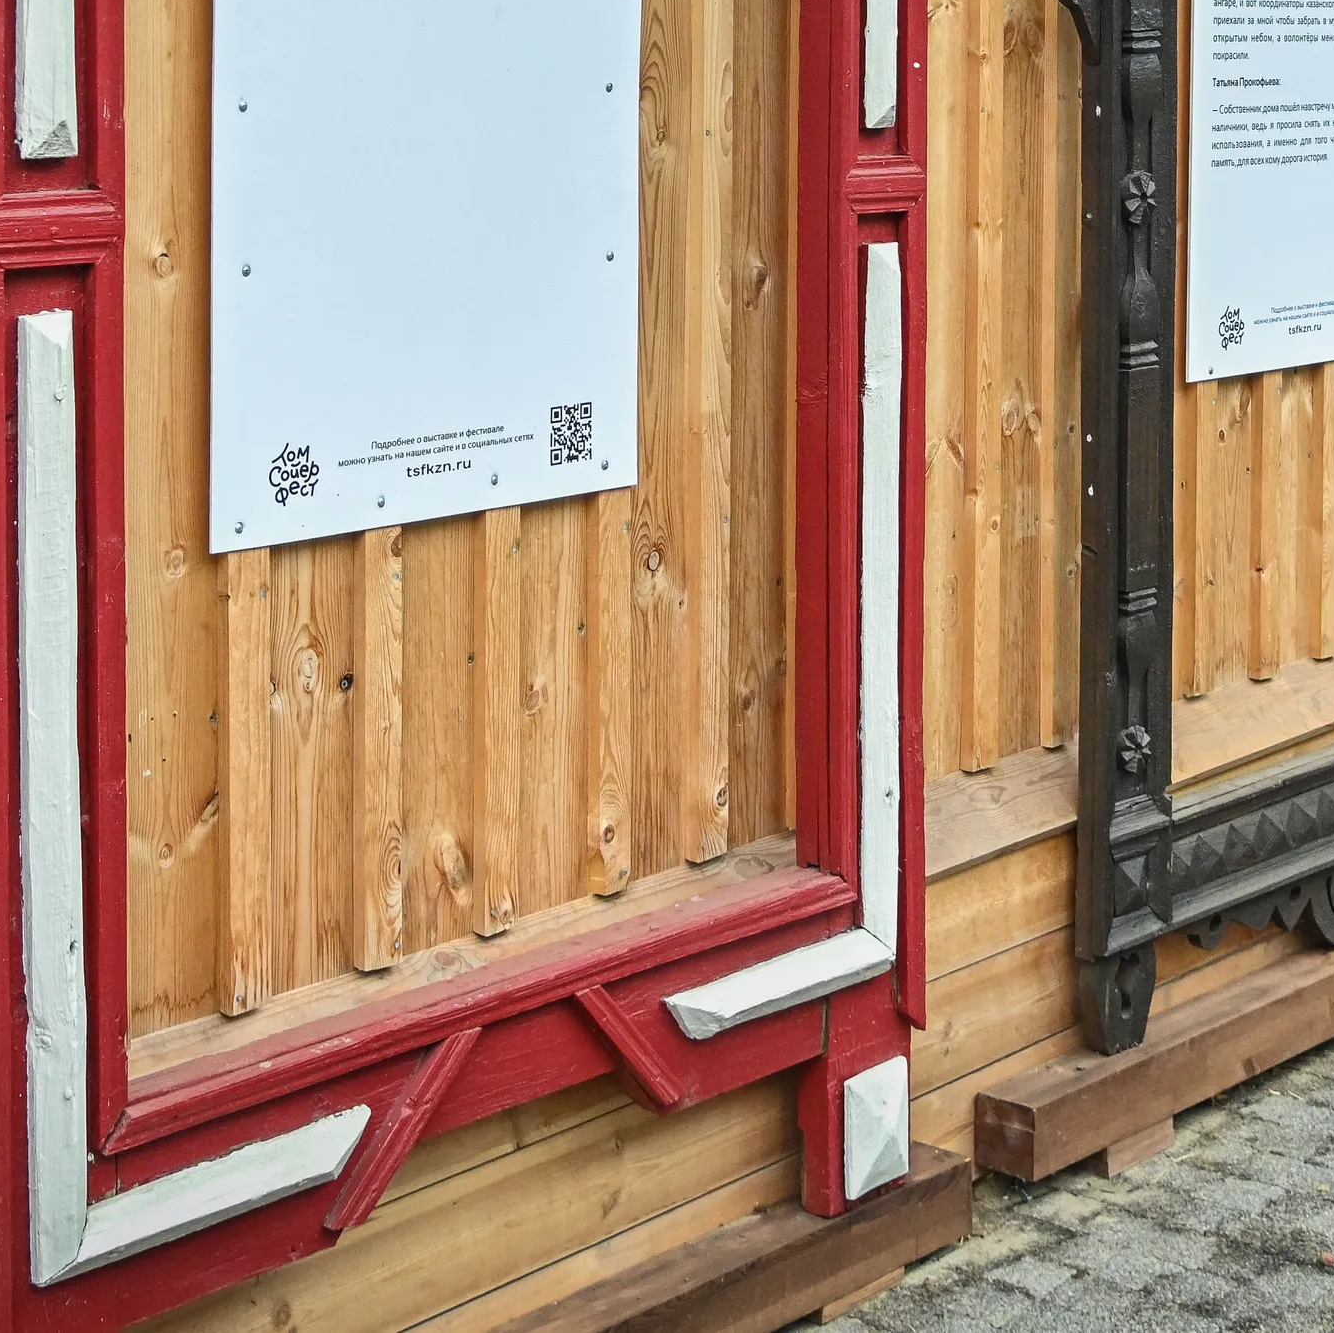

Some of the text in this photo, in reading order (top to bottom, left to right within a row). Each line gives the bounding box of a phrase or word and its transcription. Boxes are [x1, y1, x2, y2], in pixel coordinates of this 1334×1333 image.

[1214, 0, 1237, 8] ангаре,
[1259, 1, 1304, 9] координаторы
[1213, 17, 1245, 26] приехали
[1257, 16, 1273, 24] мной
[1276, 16, 1295, 24] чтобы
[1297, 16, 1320, 26] забрать
[1213, 34, 1247, 43] открытым
[1251, 33, 1273, 42] небом,
[1213, 78, 1238, 87] Татьяна
[1219, 104, 1261, 114] Собственник
[1262, 105, 1279, 114] дома
[1301, 103, 1330, 112] навстречу
[1212, 123, 1249, 132] наличники,
[1252, 123, 1267, 132] ведь
[1277, 121, 1301, 130] просила
[1304, 120, 1320, 128] снять
[1212, 140, 1264, 150] использования,
[1300, 137, 1311, 147] для
[1315, 136, 1327, 144] того
[1211, 158, 1236, 167] память,
[1237, 159, 1249, 168] для
[1281, 154, 1302, 165] дорога
[1220, 305, 1240, 322] Том
[1219, 319, 1245, 336] Сойер
[1289, 324, 1321, 335] tsfkzn.ru
[371, 436, 415, 450] Подробнее
[424, 431, 457, 442] выставке
[466, 425, 504, 437] фестивале
[272, 443, 310, 467] Том
[338, 457, 365, 467] можно
[368, 453, 392, 464] узнать
[406, 448, 431, 457] нашем
[433, 444, 453, 453] сайте
[468, 436, 513, 450] социальных
[515, 434, 534, 443] сетях
[269, 460, 319, 487] Сойер
[407, 460, 471, 477] tsfkzn.ru
